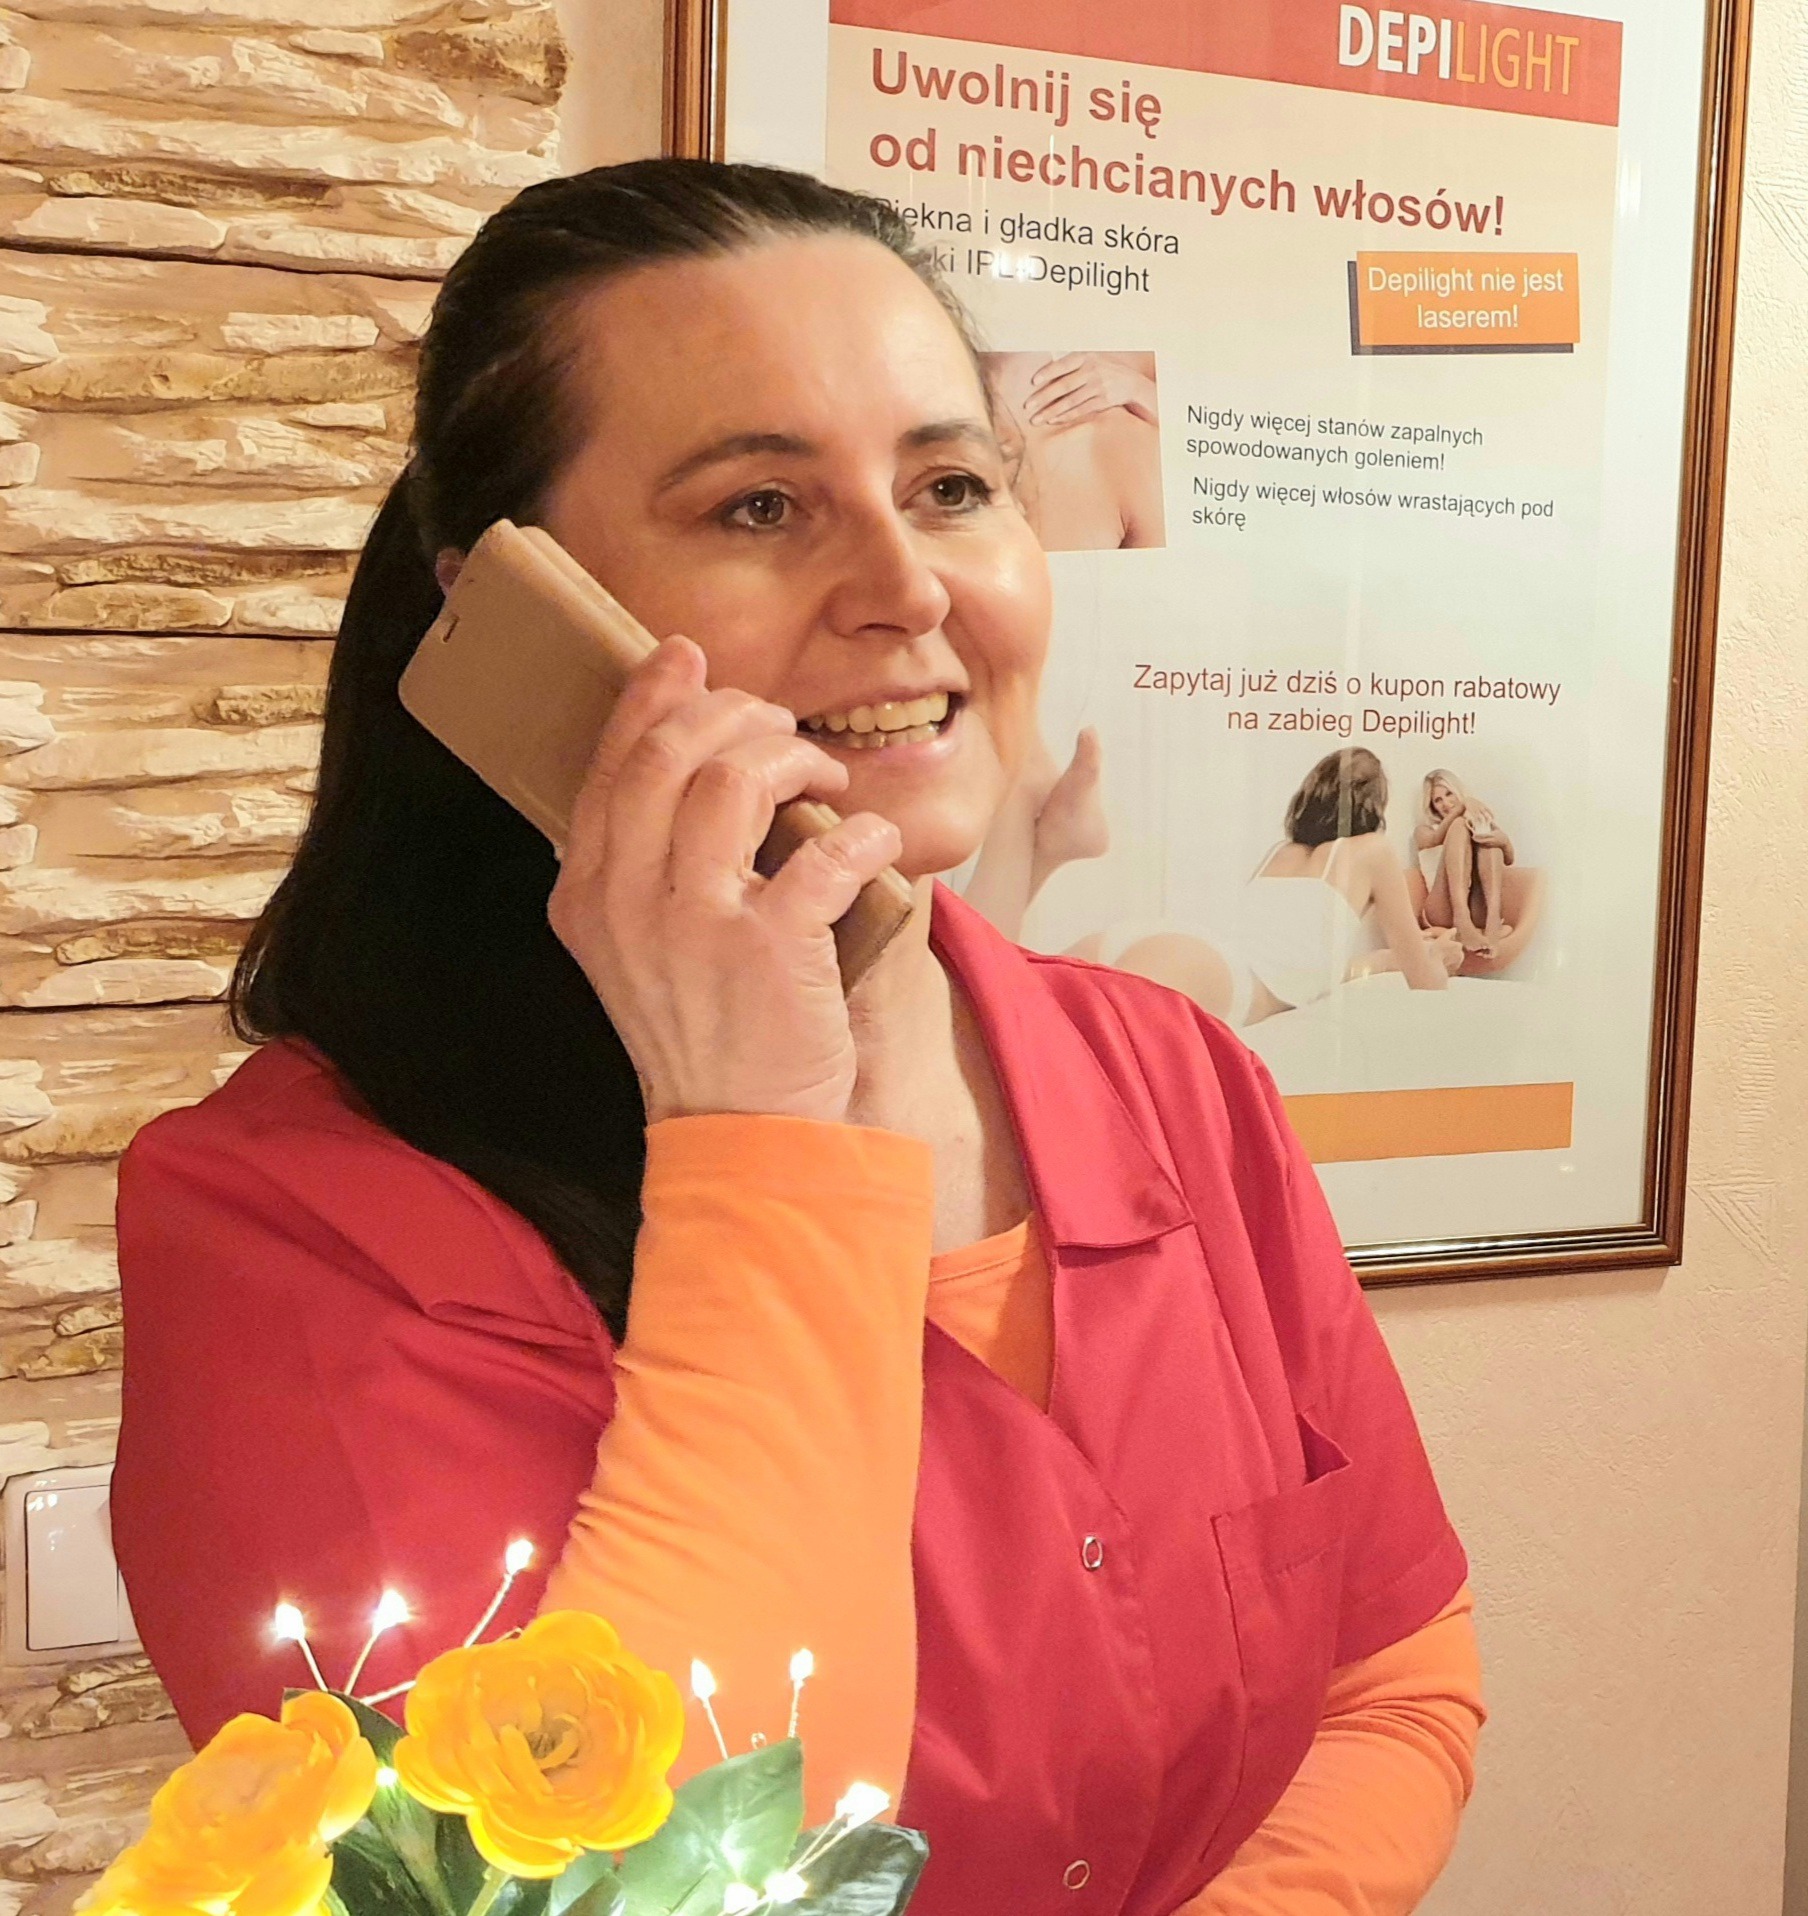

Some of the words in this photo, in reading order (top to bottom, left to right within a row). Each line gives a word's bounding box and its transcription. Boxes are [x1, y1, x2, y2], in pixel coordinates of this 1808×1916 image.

[1339, 3, 1581, 95] DEPILIGHT
[872, 48, 1071, 127] Uwolnij
[1088, 81, 1162, 139] się
[869, 127, 936, 172] od
[957, 134, 1296, 215] niechcianych
[1313, 179, 1504, 235] włosów!
[1000, 212, 1093, 246] gładka
[1104, 224, 1179, 255] skóra
[1368, 266, 1474, 298] Depilight
[1481, 267, 1516, 292] nie
[1521, 267, 1564, 298] jest
[1417, 304, 1518, 329] laserem!
[1187, 404, 1244, 432] Nigdy
[1250, 411, 1311, 438] więcej
[1317, 417, 1385, 438] stanów
[1390, 424, 1483, 449] zapalnych
[1186, 438, 1348, 467] spowodowanych
[1354, 448, 1445, 471] goleniem!
[1192, 506, 1246, 532] skórę
[1193, 476, 1250, 503] Nigdy
[1255, 482, 1316, 508] więcej
[1322, 486, 1392, 507] włosów
[1397, 494, 1515, 518] wrastających
[1521, 500, 1554, 520] pod
[1133, 664, 1231, 698] Zapytaj
[1238, 668, 1278, 698] już
[1286, 669, 1337, 694] dziś
[1346, 677, 1362, 695] o
[1370, 672, 1444, 702] kupon
[1454, 675, 1561, 706] rabatowy
[1228, 711, 1258, 730] na
[1267, 707, 1353, 738] zabieg
[1362, 709, 1475, 740] Depilight!
